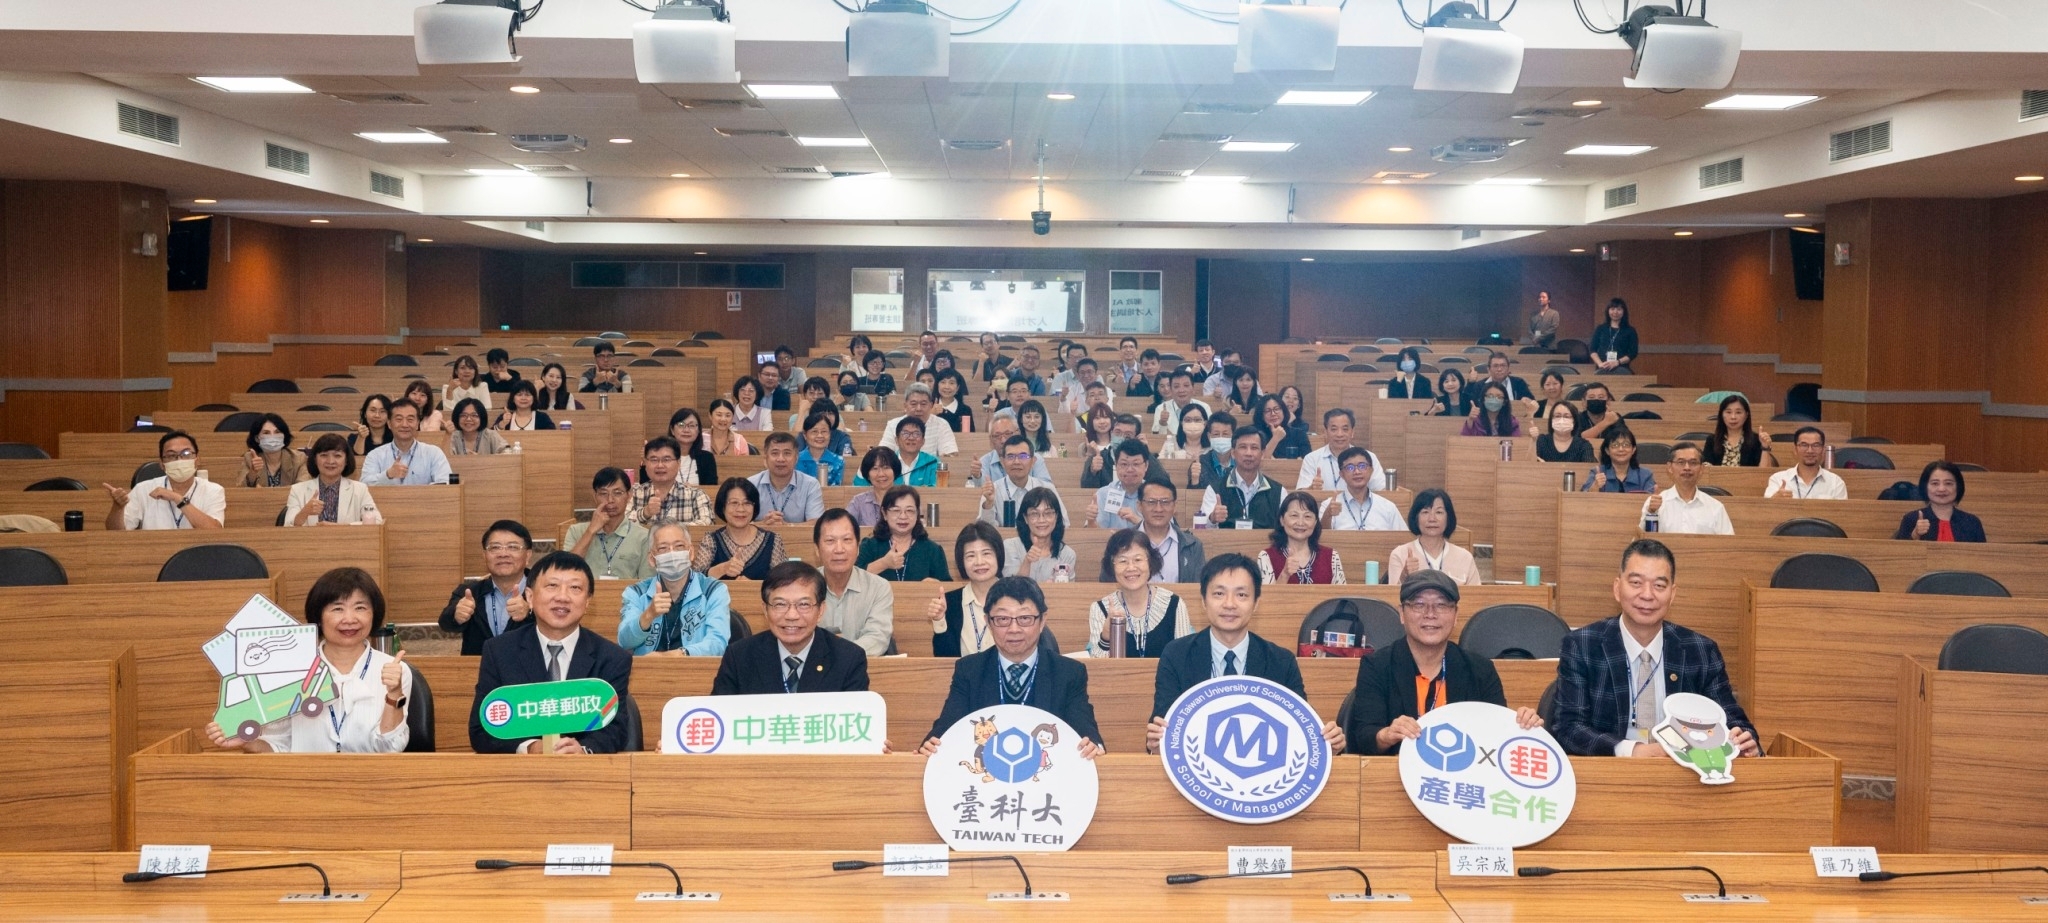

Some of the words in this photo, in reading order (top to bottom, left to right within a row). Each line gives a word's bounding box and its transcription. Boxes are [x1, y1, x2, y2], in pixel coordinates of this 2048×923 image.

[516, 694, 603, 720] 中華郵政
[732, 711, 873, 746] 中華郵政
[1170, 714, 1185, 749] National
[1180, 695, 1205, 721] Taiwan
[1206, 684, 1249, 698] University
[1250, 684, 1261, 693] of
[1261, 687, 1295, 710] Science
[1293, 708, 1307, 724] and
[1304, 722, 1323, 770] Technology
[1177, 764, 1211, 801] School
[1214, 797, 1228, 808] of
[1231, 783, 1312, 814] Management
[1418, 775, 1558, 825] 產學合作
[953, 785, 1063, 830] 臺科大
[952, 829, 1016, 843] TAIWAN
[1021, 833, 1064, 845] TECH
[1236, 856, 1287, 875] 曹譽鐘
[1456, 854, 1509, 873] 吳宗成
[1821, 856, 1875, 873] 羅乃維
